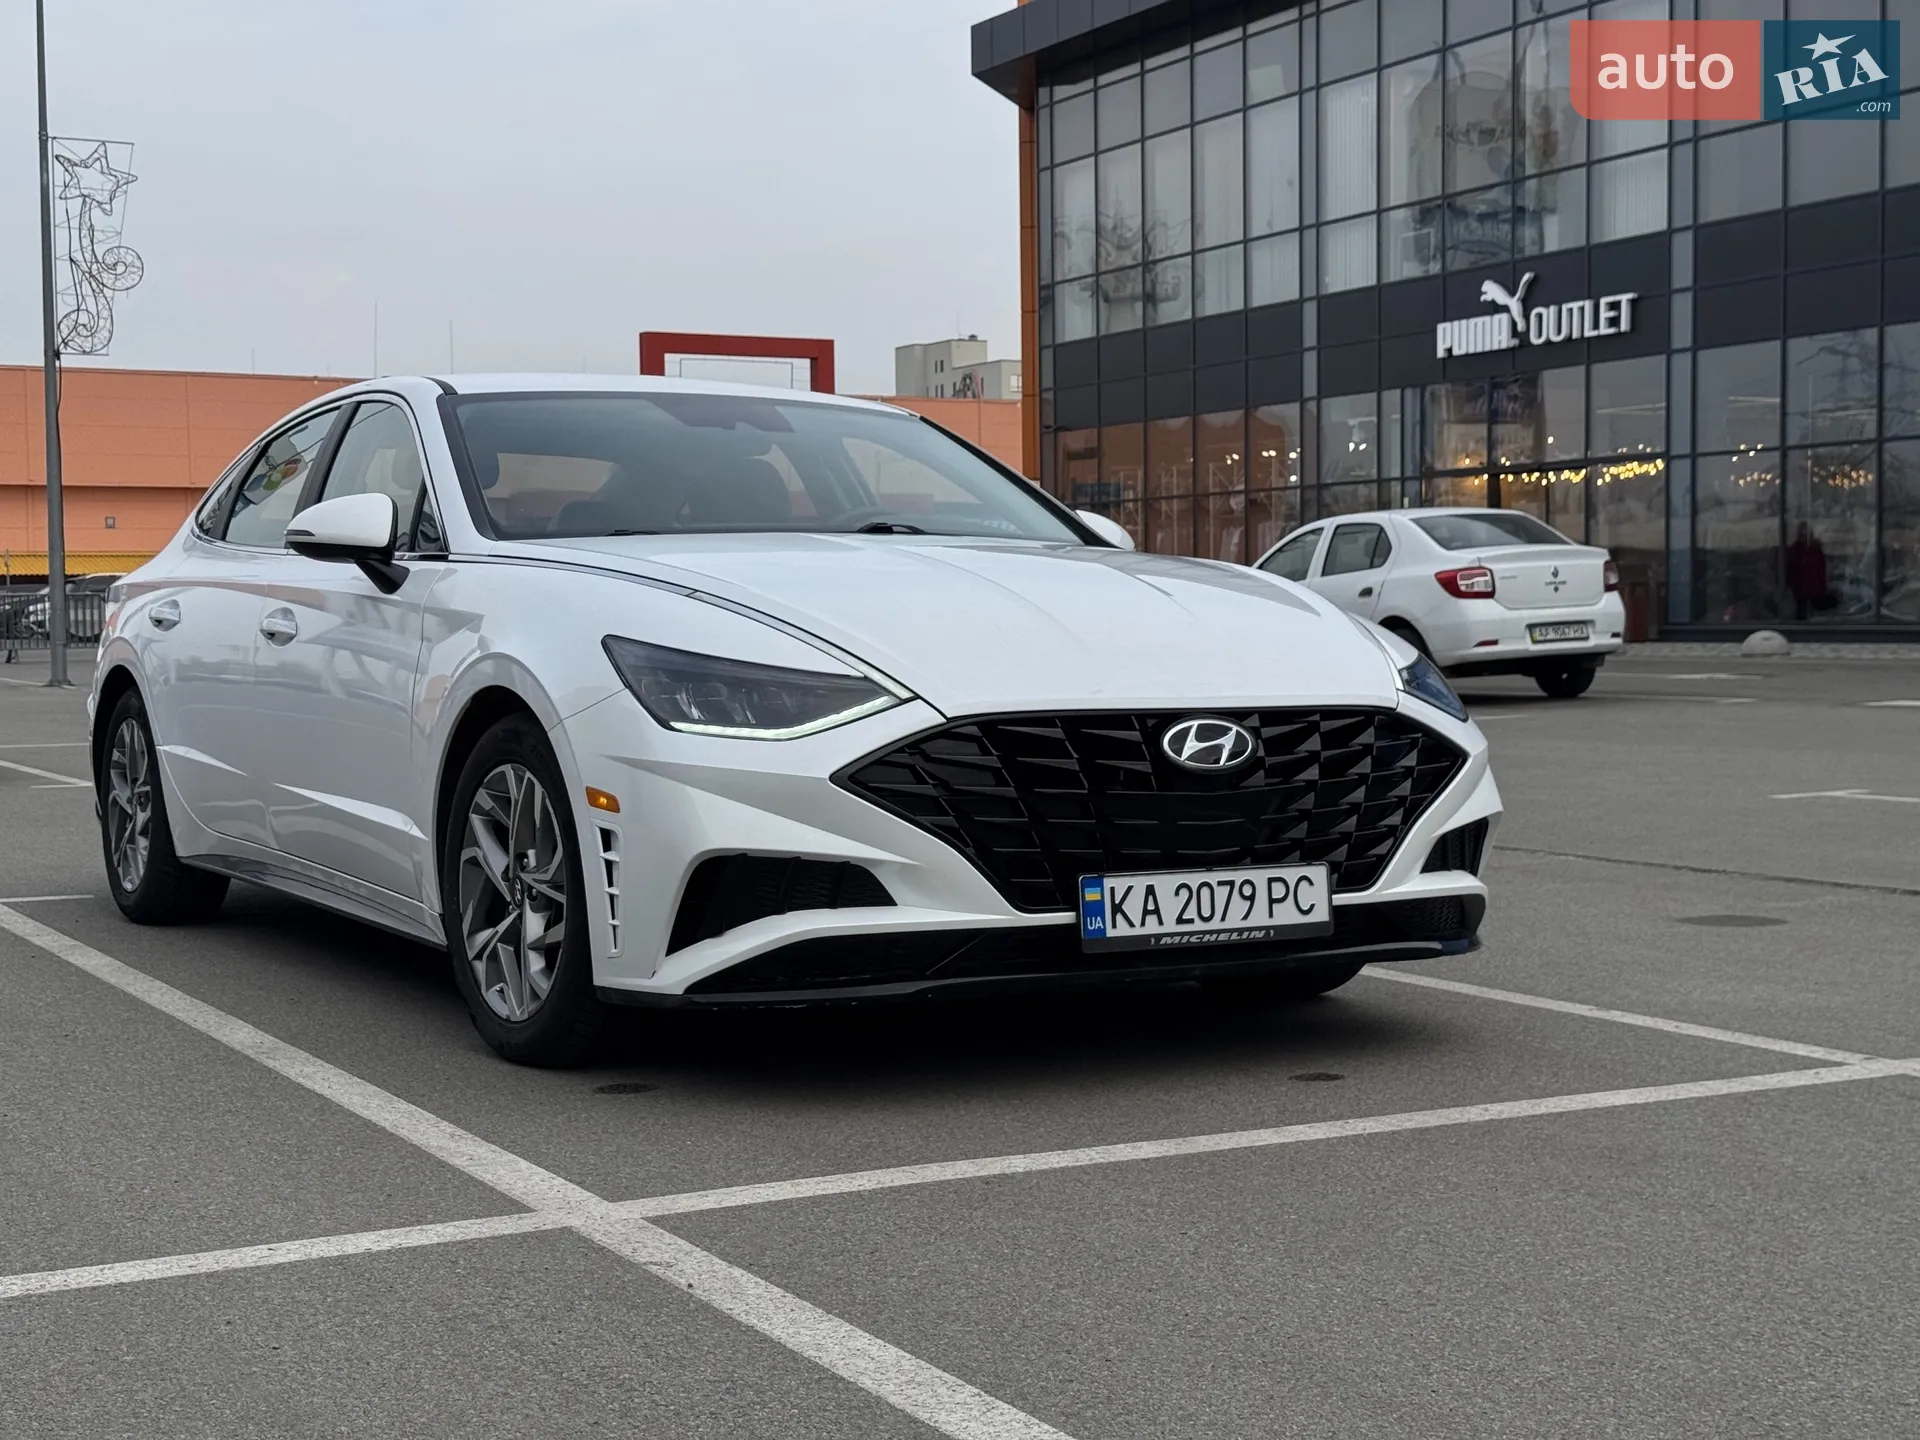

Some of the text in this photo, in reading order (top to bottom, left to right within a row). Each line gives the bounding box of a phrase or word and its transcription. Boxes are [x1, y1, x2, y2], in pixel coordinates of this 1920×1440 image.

[1436, 292, 1638, 359] PUMA OUTLET
[1109, 874, 1317, 929] KA 2079 PC
[1087, 915, 1104, 930] UA
[1159, 929, 1267, 945] MICHELIN
